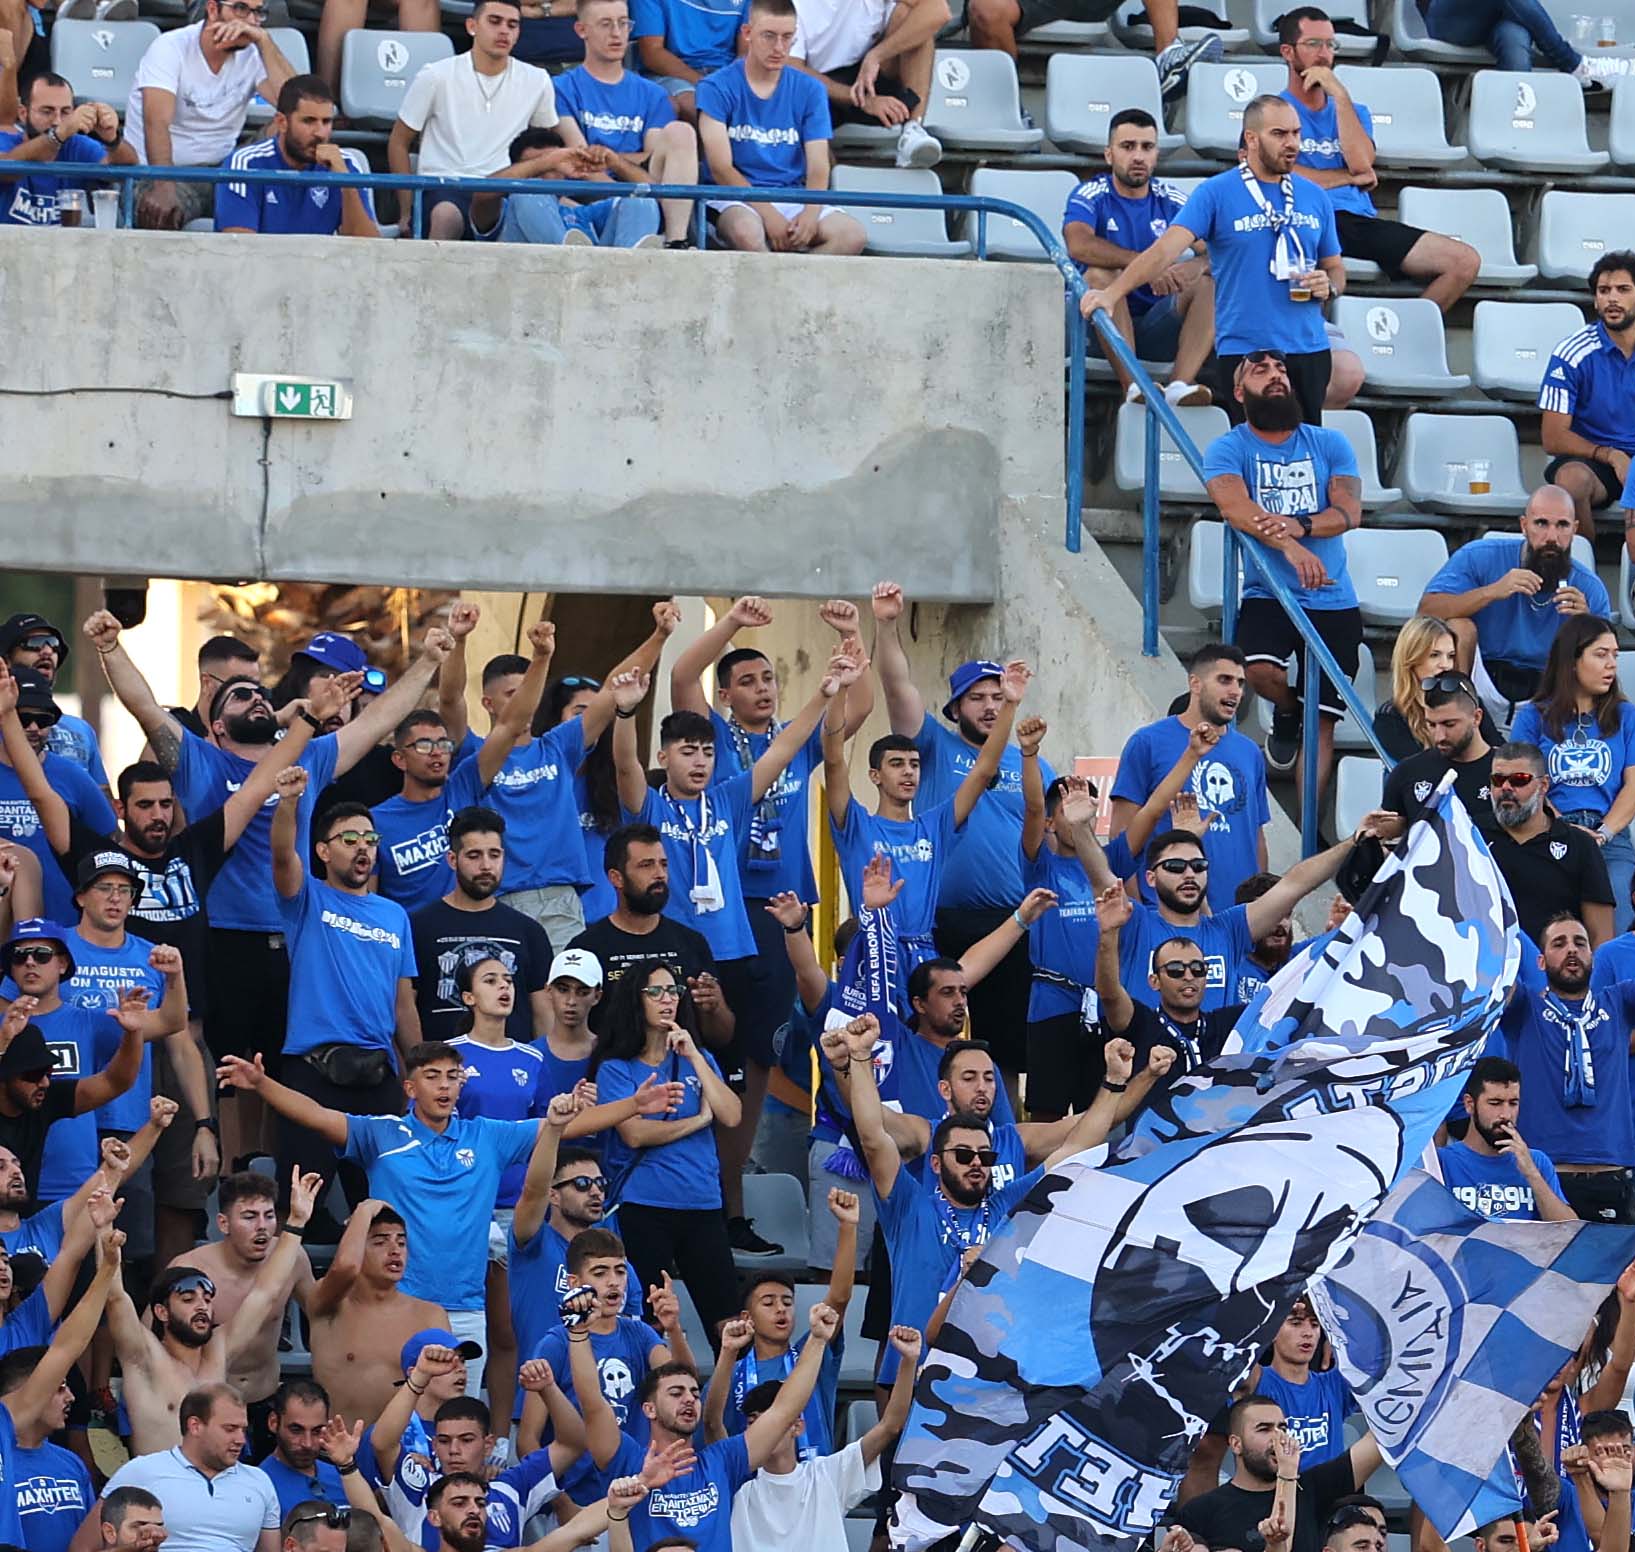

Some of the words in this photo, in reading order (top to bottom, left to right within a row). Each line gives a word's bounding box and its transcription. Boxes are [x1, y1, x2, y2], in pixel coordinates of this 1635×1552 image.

[1209, 822, 1231, 833] 1994
[73, 966, 146, 978] MAGUSTA
[71, 978, 90, 989] ON
[97, 978, 136, 990] TOUR
[871, 972, 882, 1002] UEFA
[1453, 1186, 1477, 1209] 19
[1503, 1186, 1534, 1211] 94
